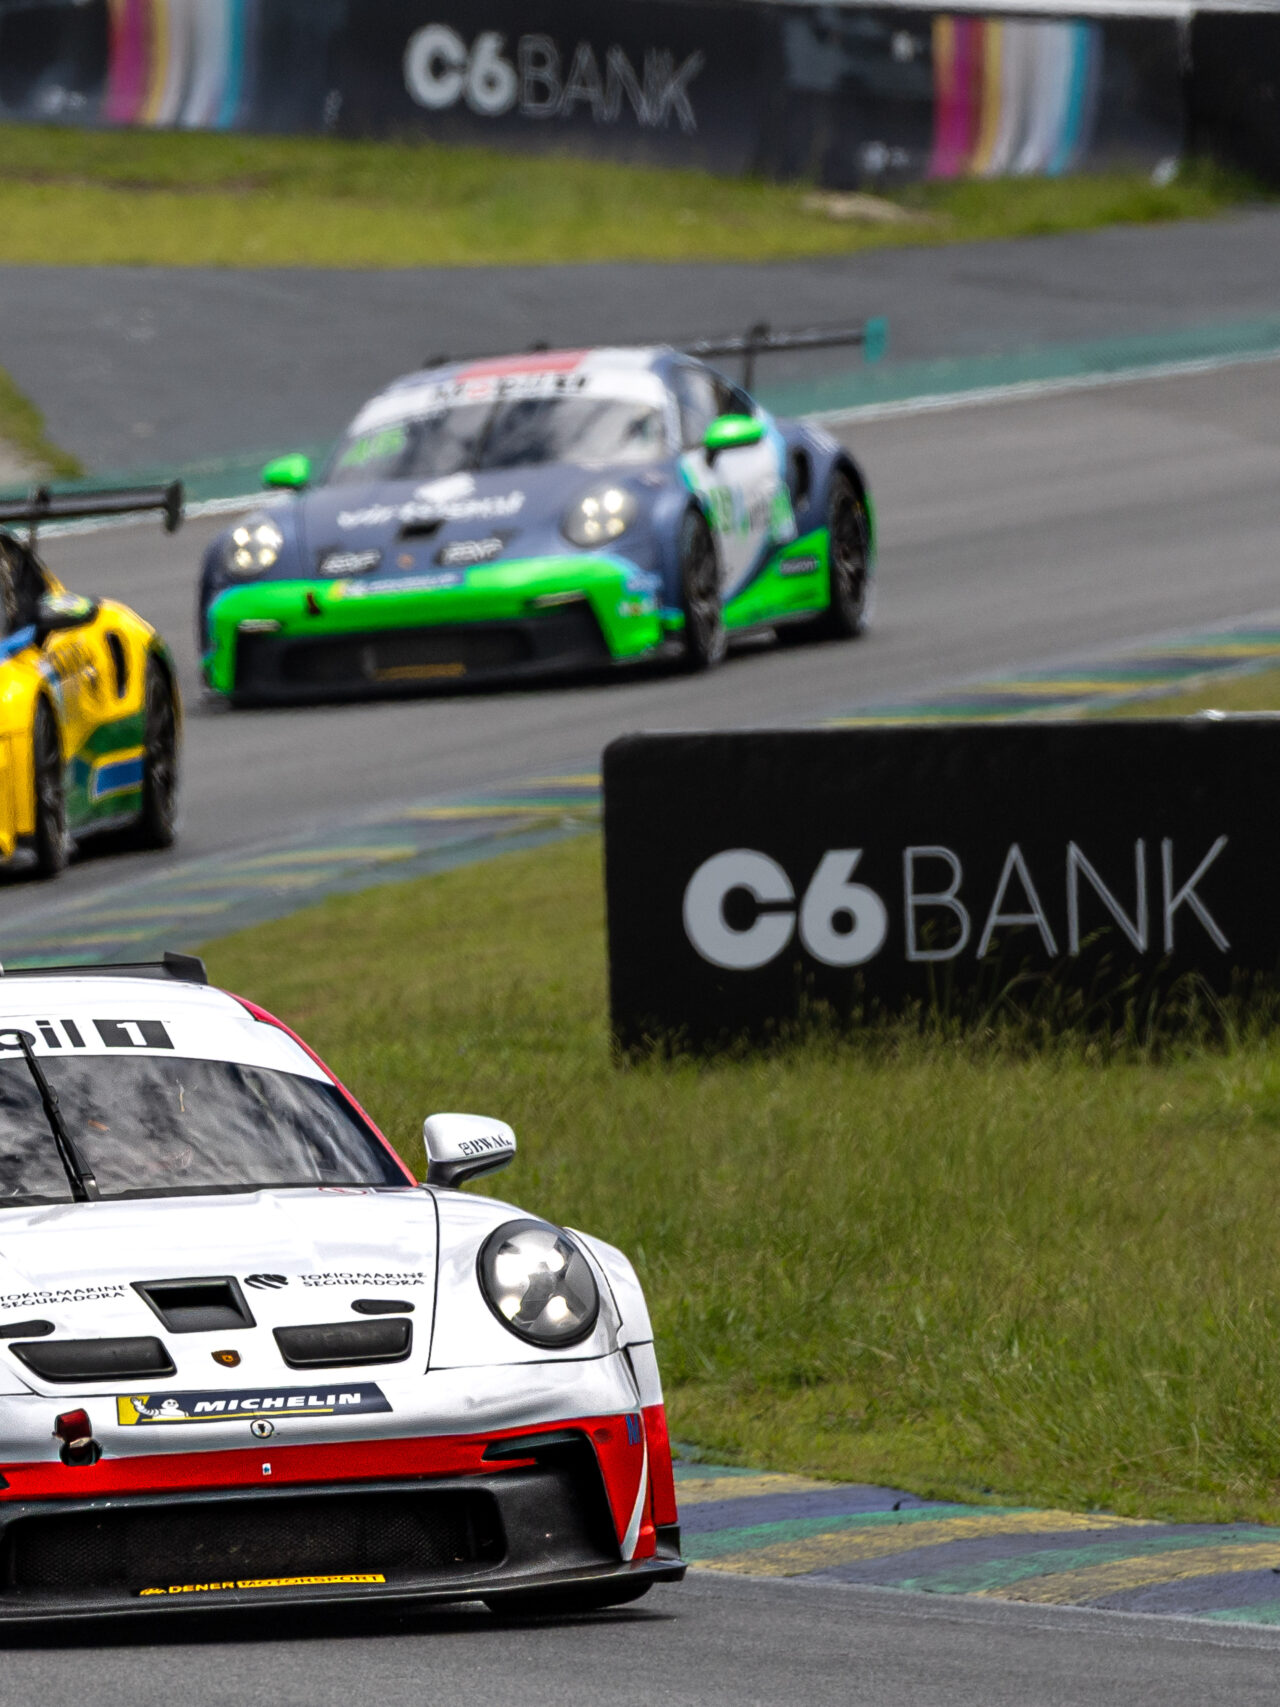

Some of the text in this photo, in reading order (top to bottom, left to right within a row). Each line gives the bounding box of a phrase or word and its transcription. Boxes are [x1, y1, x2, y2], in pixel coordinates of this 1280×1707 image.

[403, 23, 706, 135] C6 BANK
[682, 835, 1231, 971] C6 BANK
[56, 1284, 129, 1296] MARINE
[303, 1279, 425, 1288] SEGURADORA
[1, 1292, 125, 1309] SEGURADORA
[193, 1393, 361, 1413] MICHELIN
[168, 1575, 382, 1594] DENER MOTORSPORT
